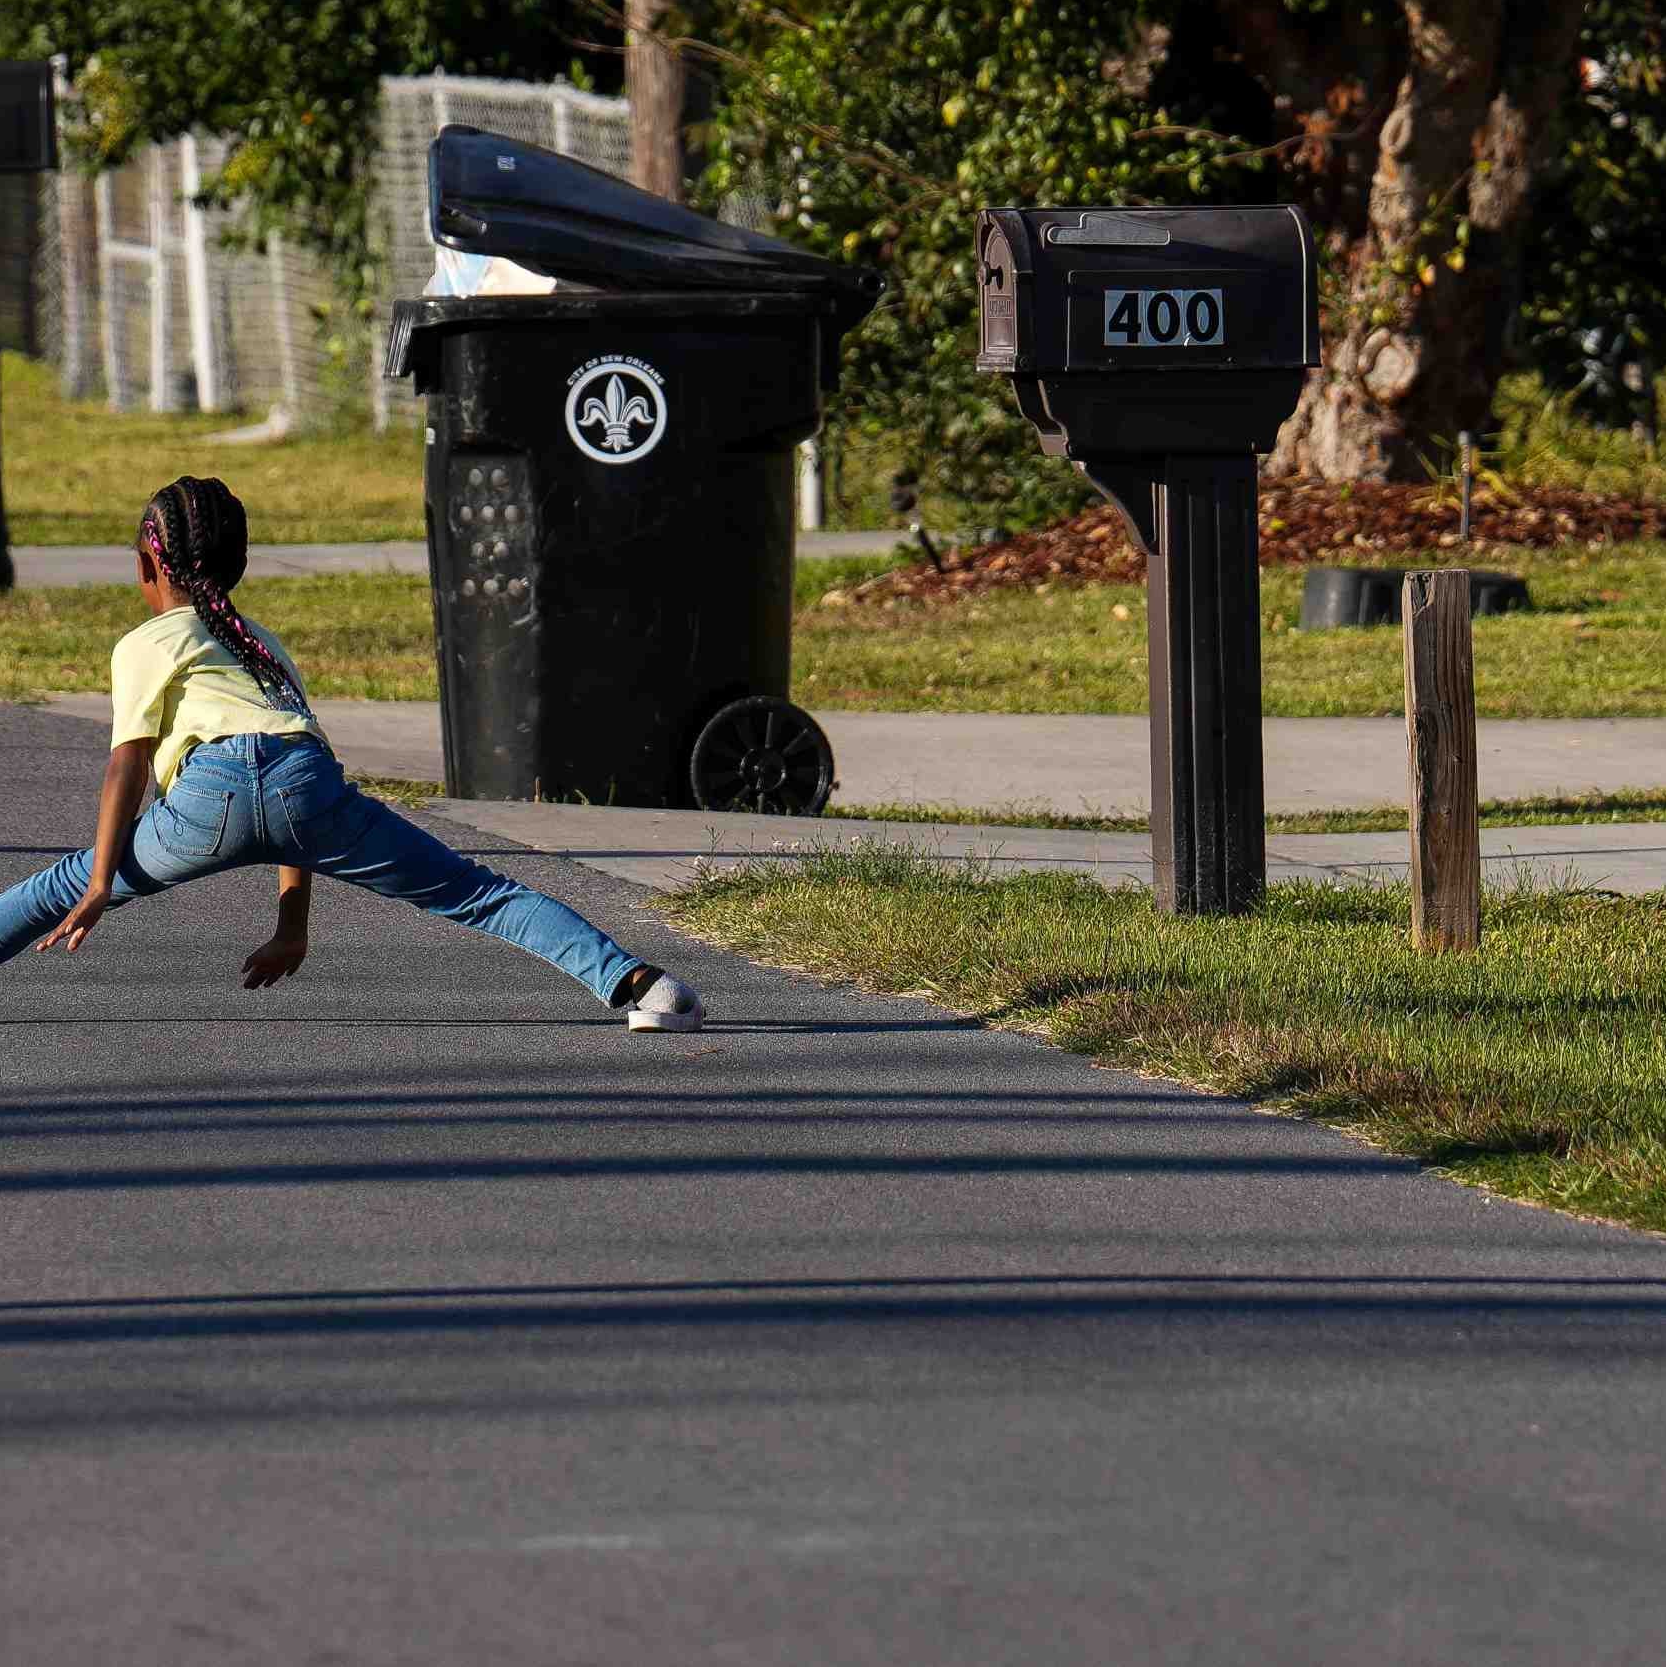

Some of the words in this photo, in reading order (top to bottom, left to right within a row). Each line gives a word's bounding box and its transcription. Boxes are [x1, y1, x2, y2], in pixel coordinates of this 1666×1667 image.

[1108, 292, 1220, 344] 400
[566, 366, 585, 386] CITY
[585, 358, 598, 369] OF
[600, 354, 623, 363] NEW
[625, 356, 666, 385] ORLEANS
